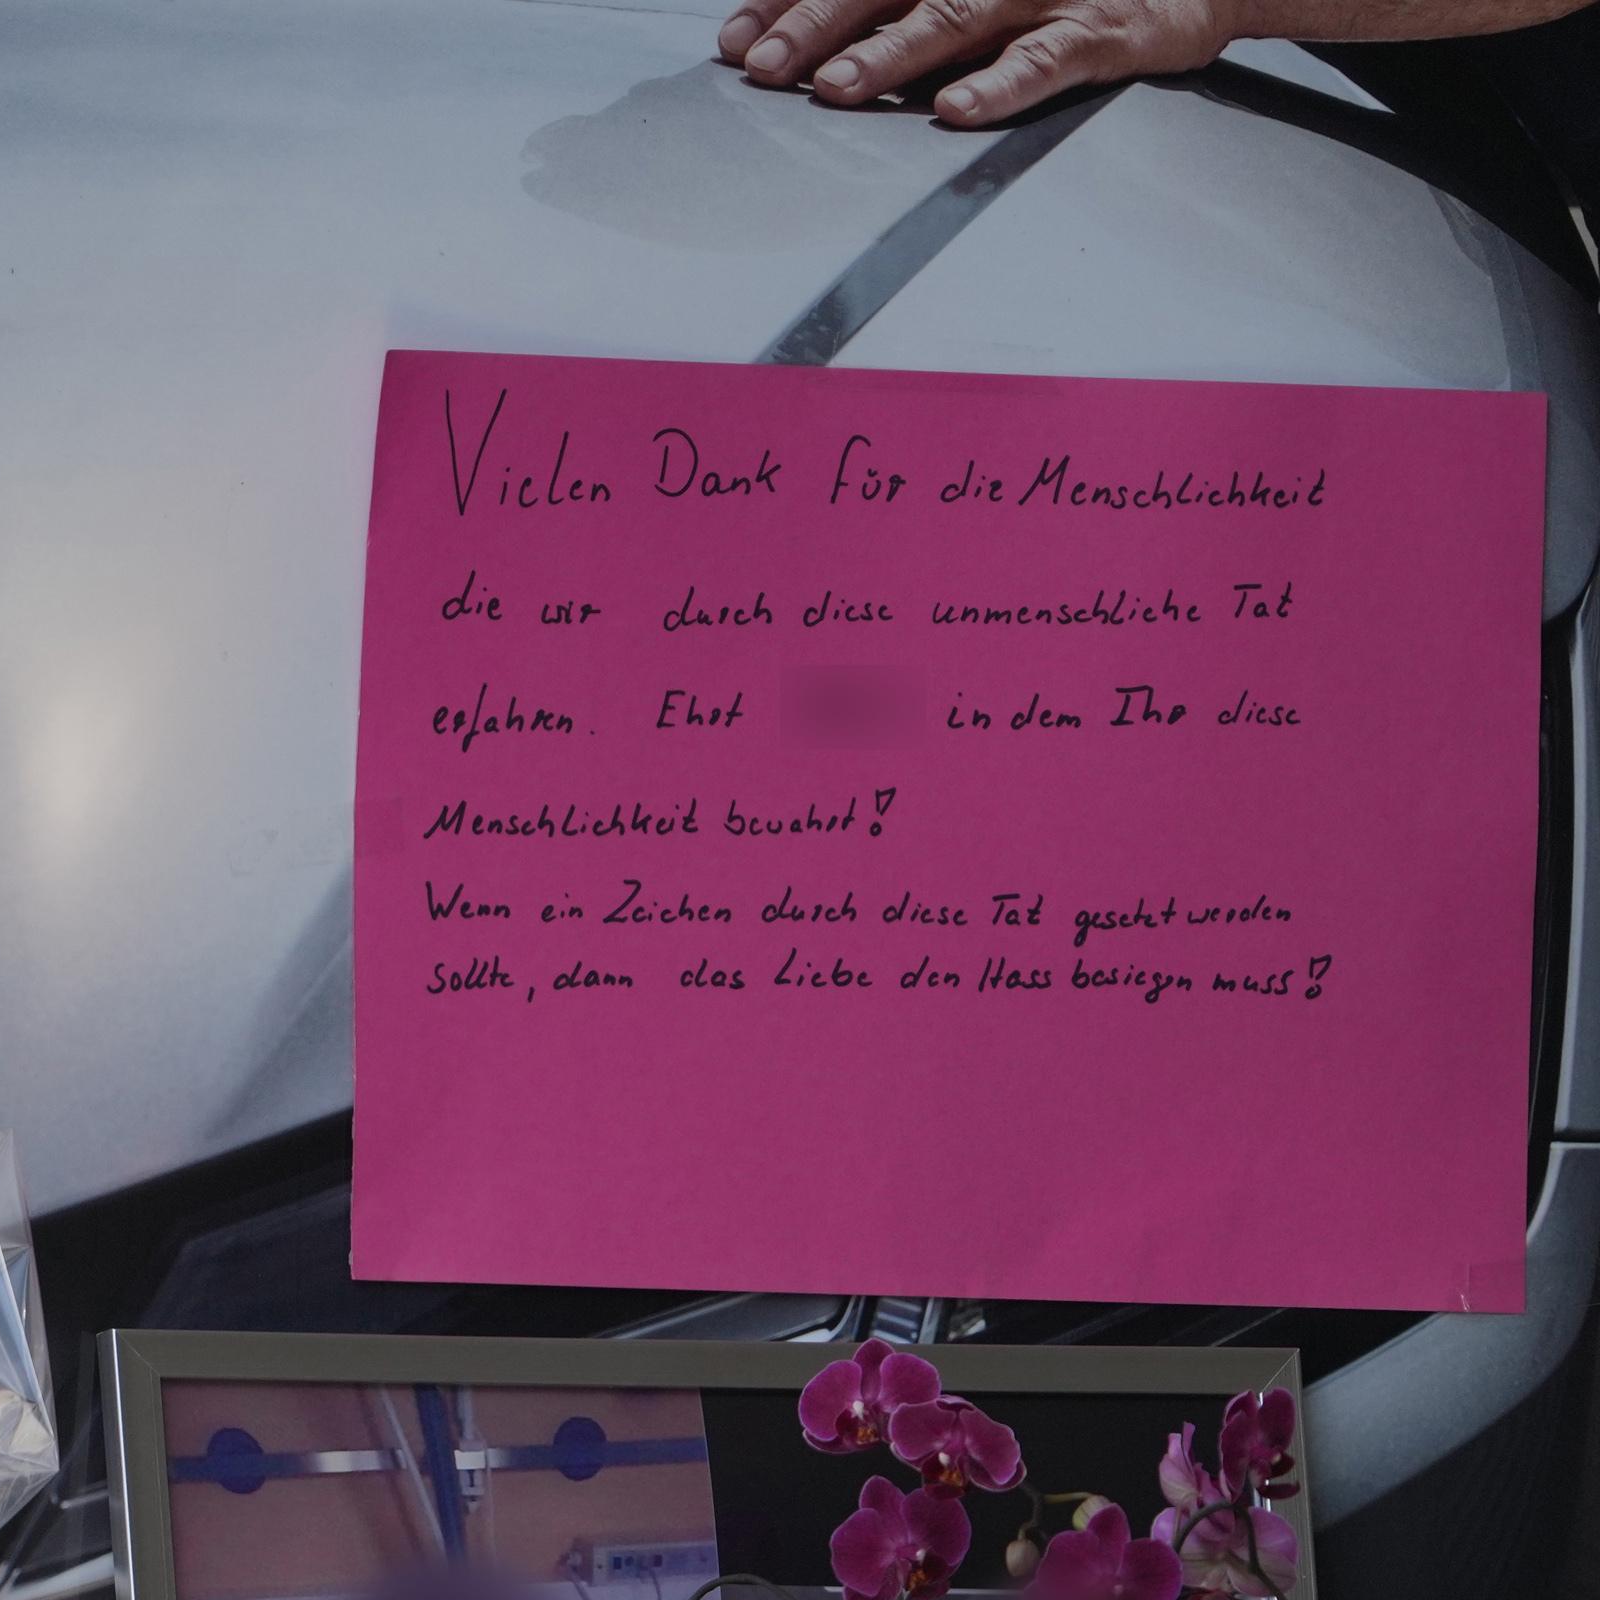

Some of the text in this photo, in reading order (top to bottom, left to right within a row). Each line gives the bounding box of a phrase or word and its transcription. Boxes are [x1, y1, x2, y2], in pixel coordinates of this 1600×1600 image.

[443, 386, 613, 518] Vielen
[651, 426, 784, 499] Dank
[938, 458, 1005, 505] die
[1016, 453, 1327, 511] Menschlichkeit
[440, 568, 1294, 634] die wir durch diese unmenschliche Tat
[654, 687, 745, 731] Ehrt
[945, 690, 993, 732] in
[1008, 691, 1083, 733] dem
[1108, 683, 1189, 728] Ihr
[1215, 687, 1303, 728] diese
[421, 796, 701, 841] Menschlichkeit
[423, 879, 513, 923] Wenn
[539, 891, 585, 925] ein
[600, 877, 734, 926] Zeichen
[759, 884, 859, 925] durch
[880, 889, 970, 928] diese
[990, 891, 1045, 928] Tat
[1185, 893, 1293, 927] werden
[551, 959, 636, 993] dann
[678, 956, 747, 992] das
[772, 945, 874, 990] Liebe
[898, 953, 962, 991] den
[976, 955, 1054, 994] Hass
